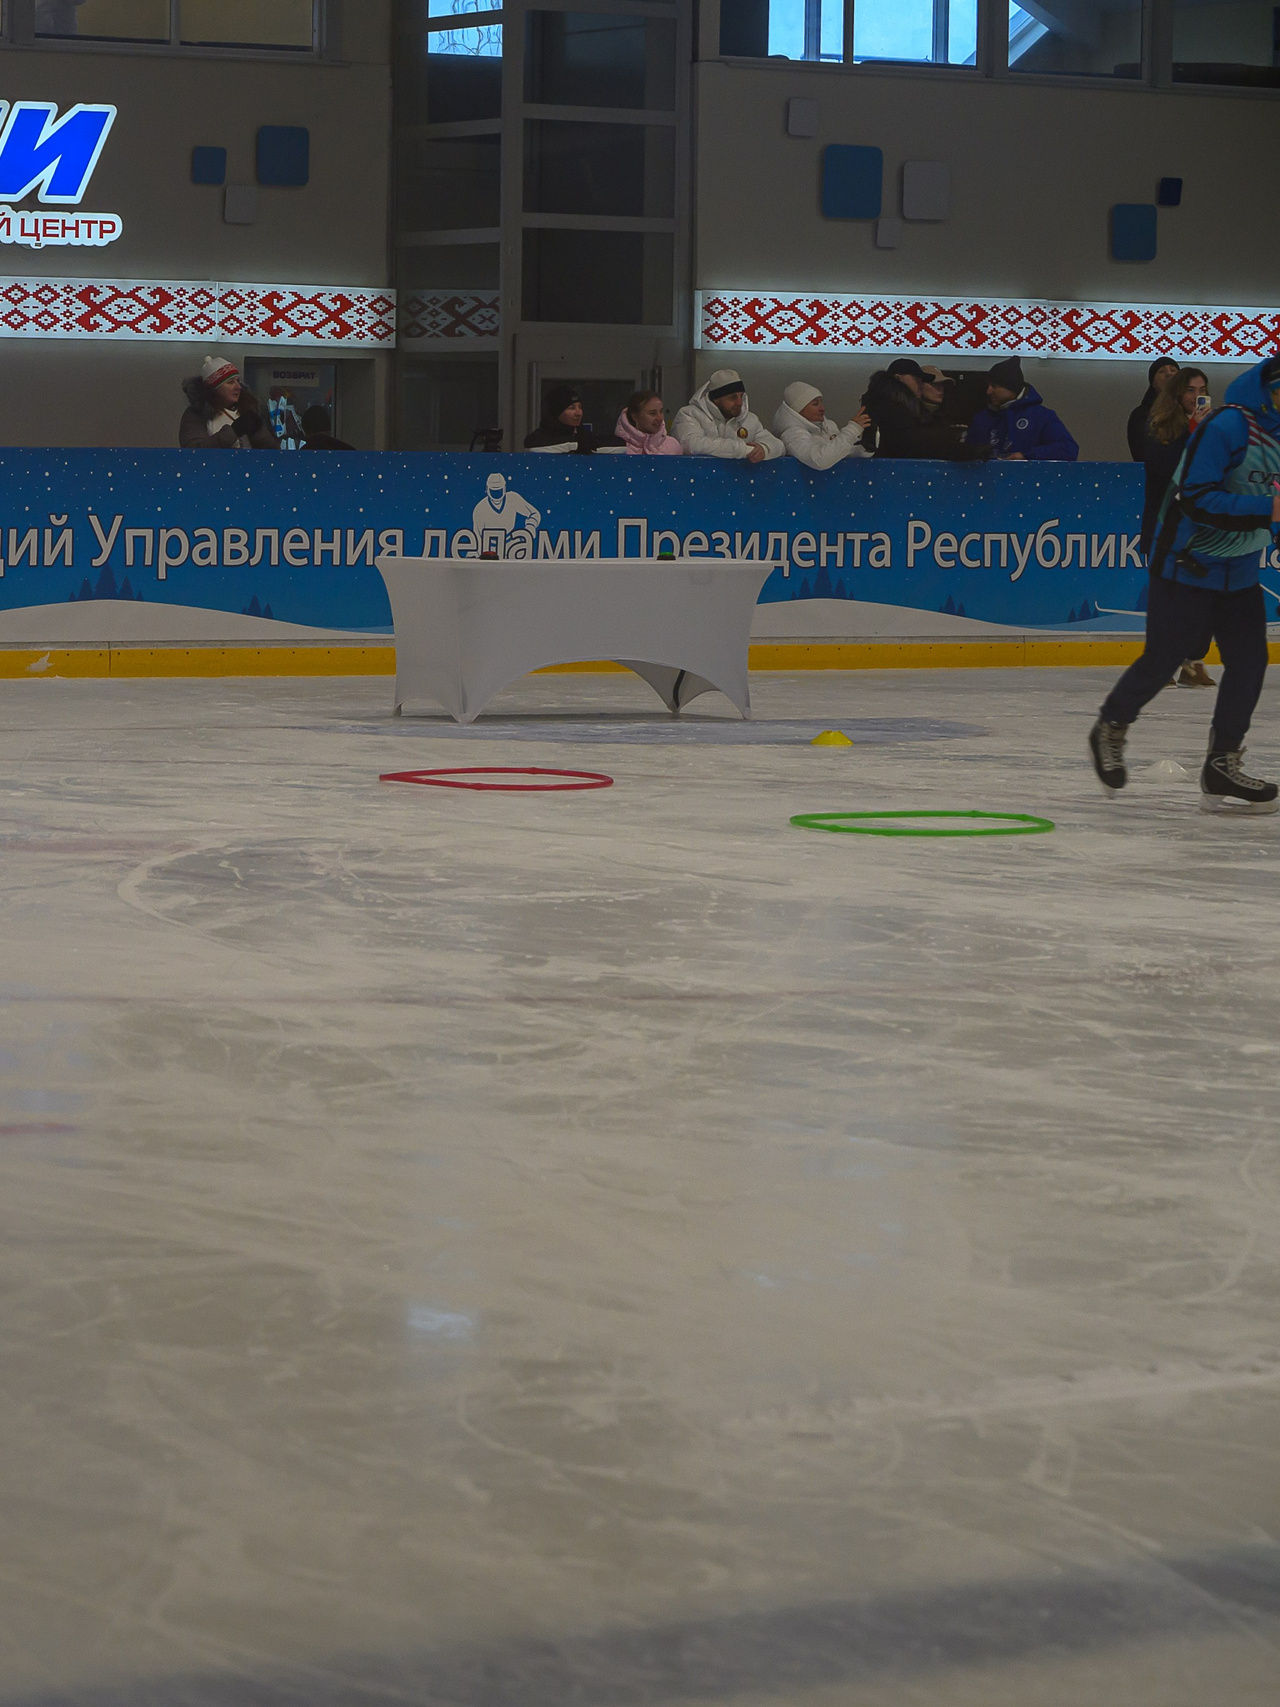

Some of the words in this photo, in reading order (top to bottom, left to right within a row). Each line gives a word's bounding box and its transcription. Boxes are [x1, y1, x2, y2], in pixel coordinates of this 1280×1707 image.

[19, 217, 117, 242] ЦЕНТР
[272, 370, 317, 381] ВОЗВРАТ
[89, 513, 405, 581] Управления
[421, 527, 601, 560] делами
[616, 517, 893, 578] Президента
[905, 517, 1149, 583] Республик
